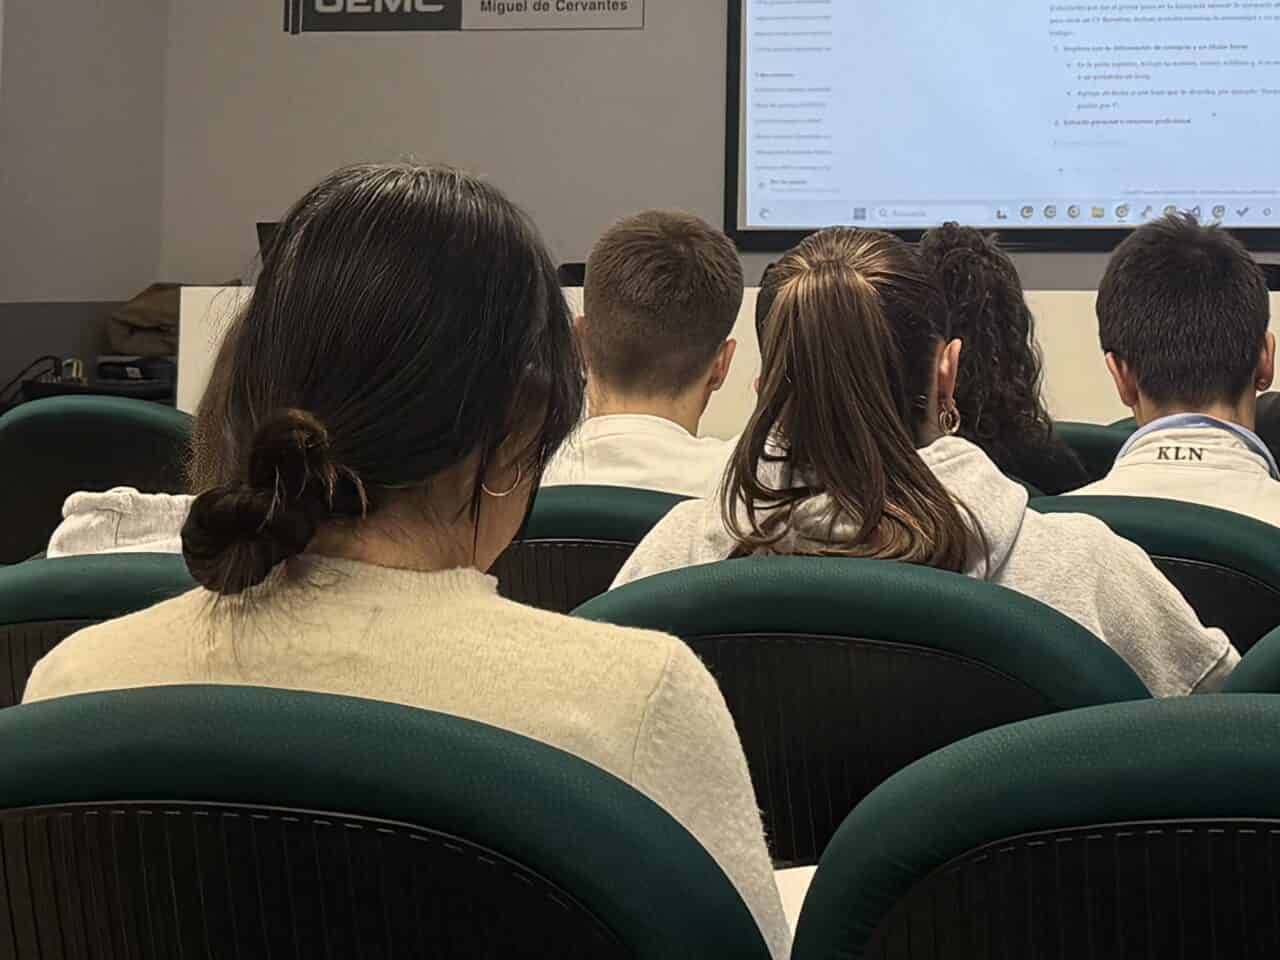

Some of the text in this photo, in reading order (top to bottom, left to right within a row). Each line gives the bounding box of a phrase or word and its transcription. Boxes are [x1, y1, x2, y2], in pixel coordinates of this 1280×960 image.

[480, 0, 629, 15] Miguel de Cervantes
[1156, 446, 1204, 461] KLN
